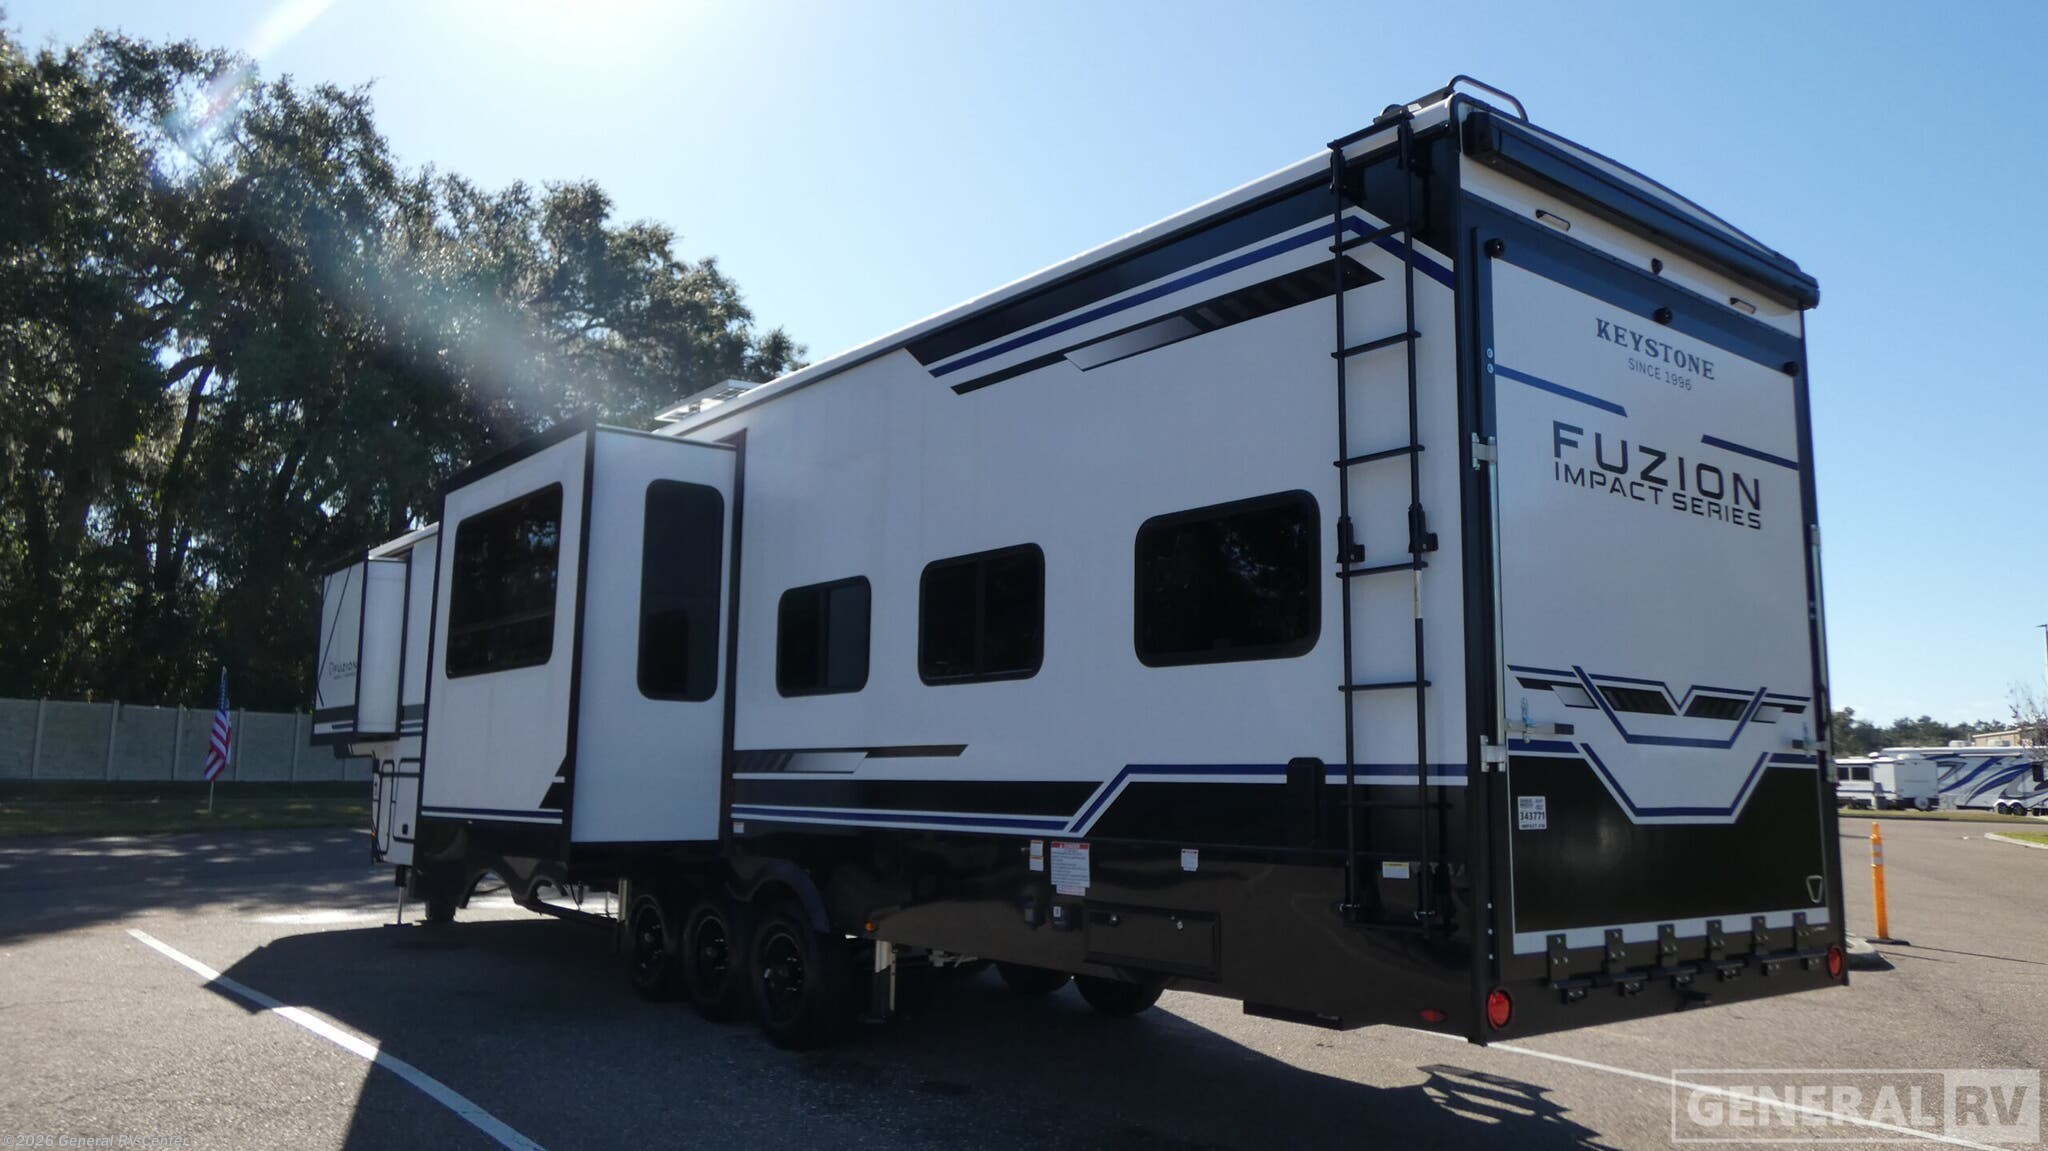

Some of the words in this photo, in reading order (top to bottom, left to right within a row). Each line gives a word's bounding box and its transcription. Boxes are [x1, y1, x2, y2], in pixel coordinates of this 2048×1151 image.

[1596, 317, 1715, 381] KEYSTONE
[1627, 357, 1661, 381] SINCE
[1665, 372, 1692, 391] 1996
[1553, 420, 1761, 511] FUZION
[1554, 461, 1664, 505] IMPACT
[1672, 492, 1762, 531] SERIES
